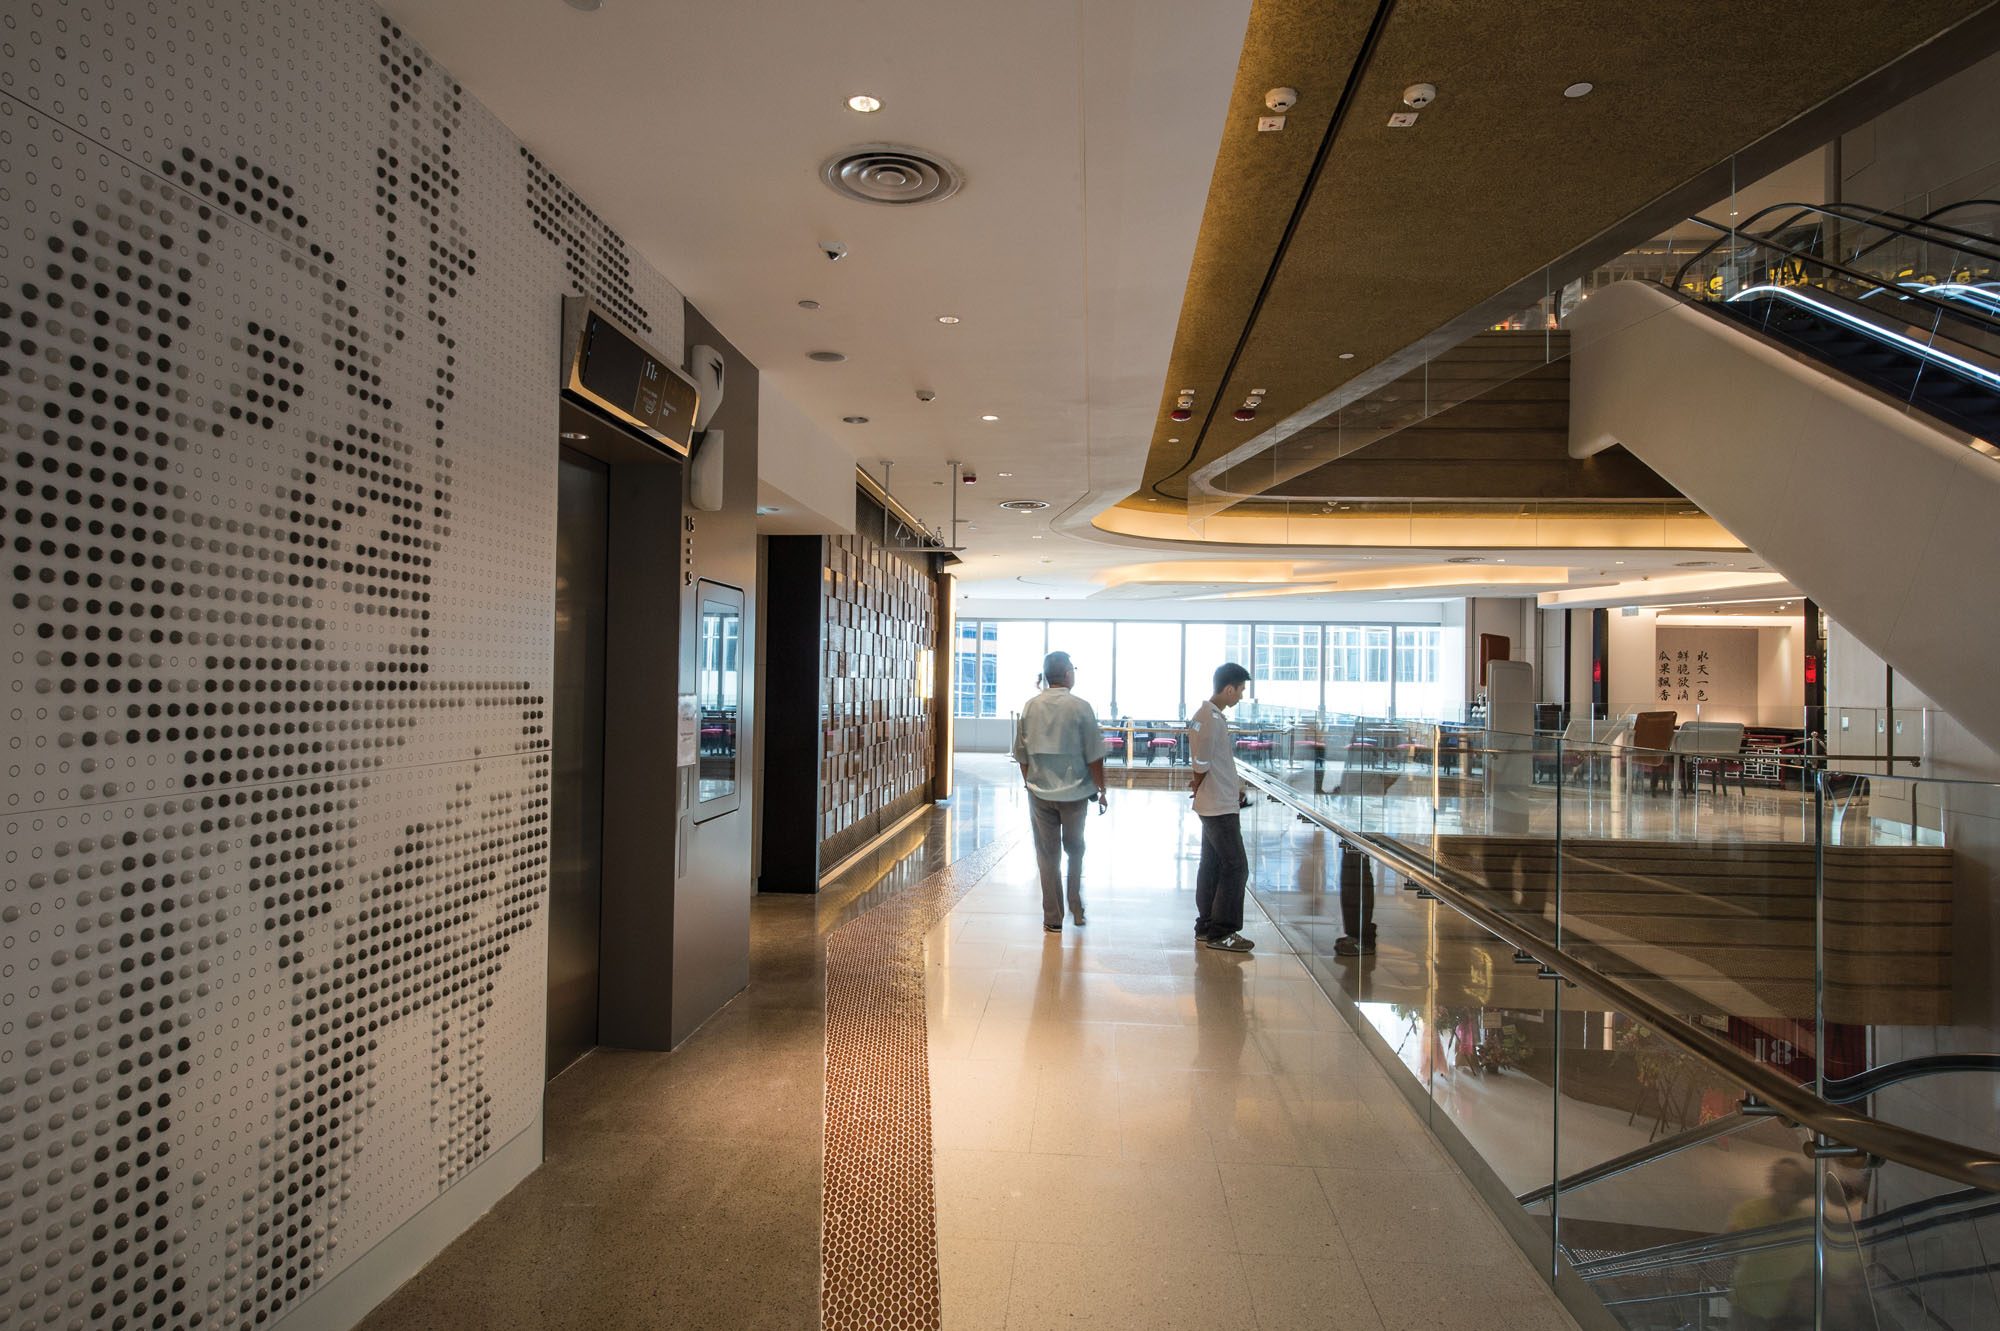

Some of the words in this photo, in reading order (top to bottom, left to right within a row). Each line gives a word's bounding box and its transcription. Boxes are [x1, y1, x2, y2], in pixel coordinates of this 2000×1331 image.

[684, 515, 696, 533] 15
[685, 571, 694, 586] 9
[1697, 650, 1709, 701] 水天一色
[1222, 937, 1235, 947] N
